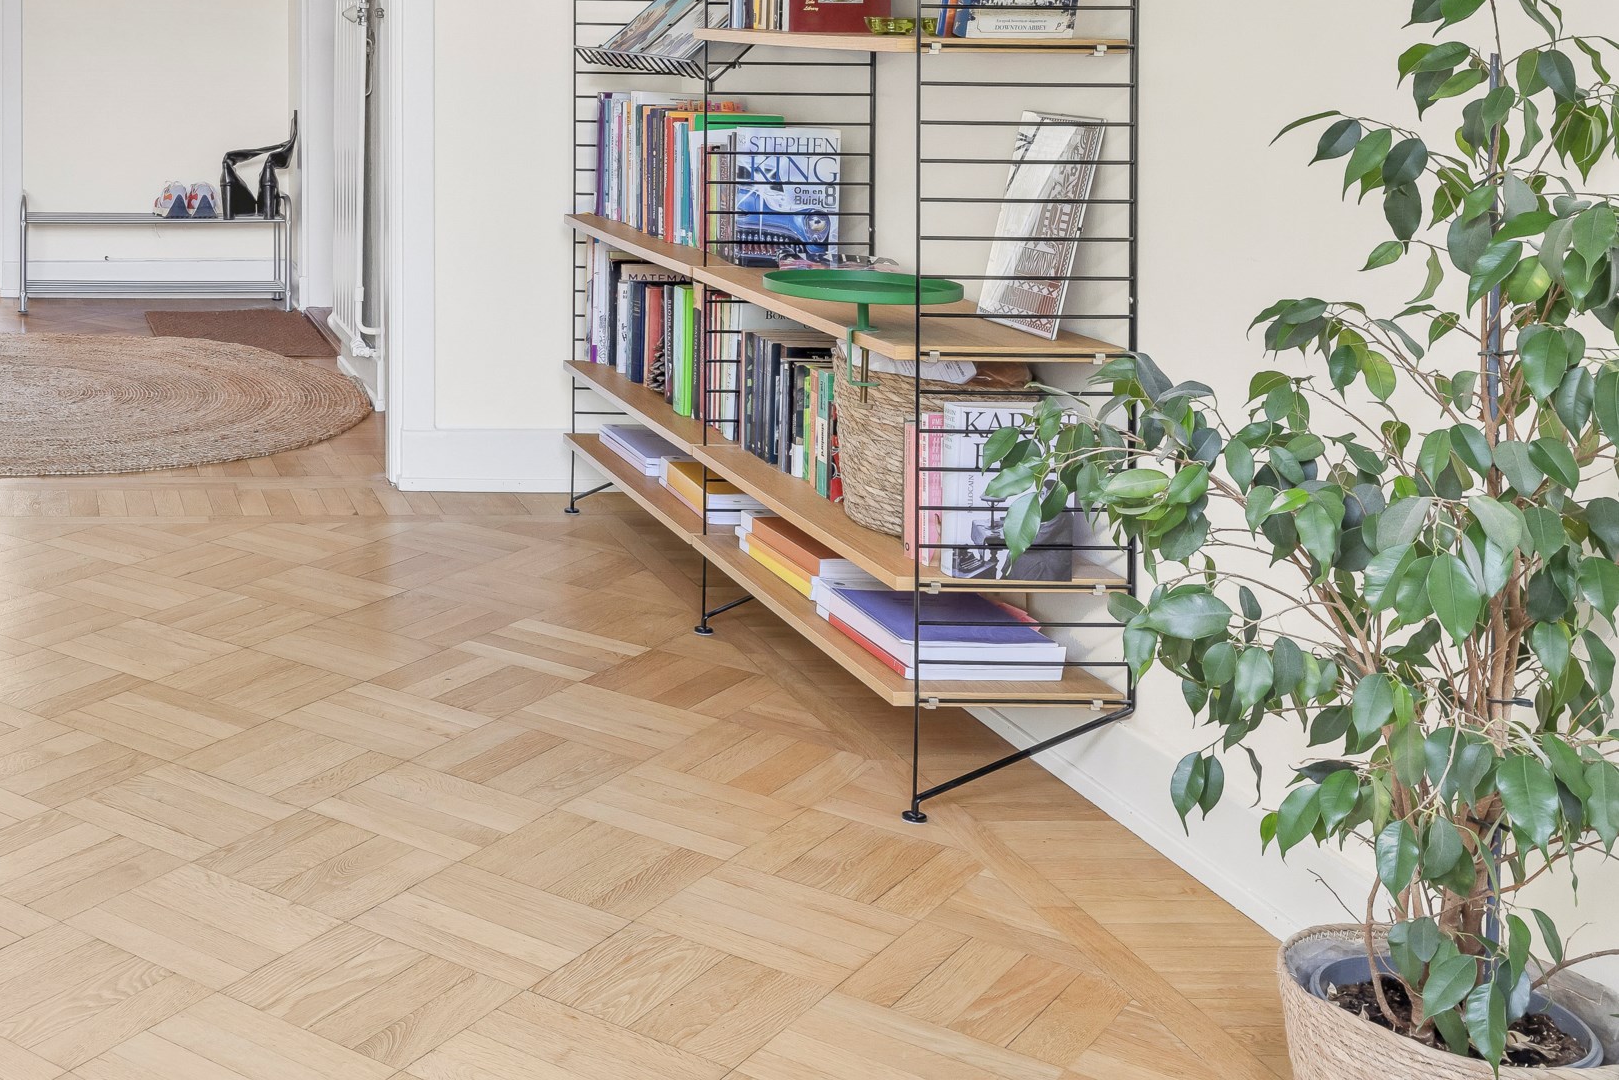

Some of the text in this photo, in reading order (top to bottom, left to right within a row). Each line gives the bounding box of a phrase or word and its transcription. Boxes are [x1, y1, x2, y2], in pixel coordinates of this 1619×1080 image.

[749, 135, 840, 153] STEPHEN
[749, 155, 840, 184] KING
[794, 186, 809, 195] Om
[794, 184, 837, 207] Buick 8
